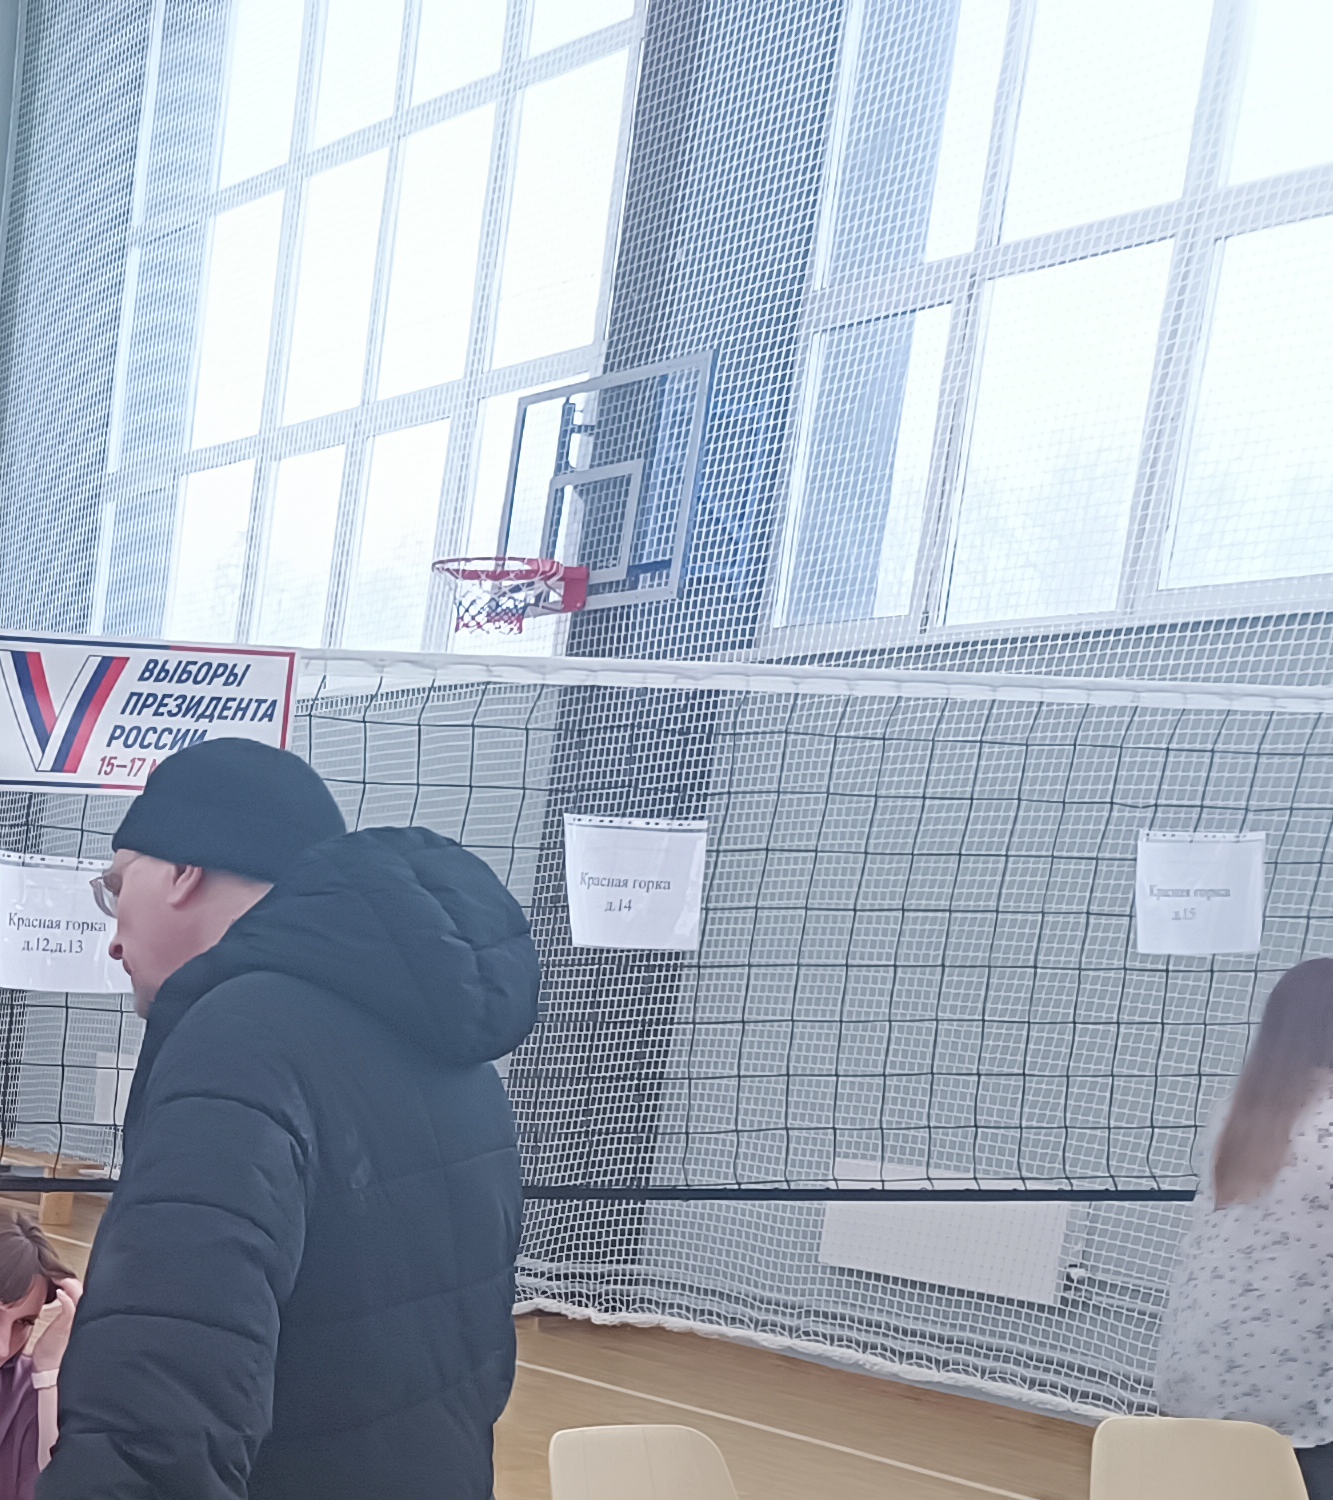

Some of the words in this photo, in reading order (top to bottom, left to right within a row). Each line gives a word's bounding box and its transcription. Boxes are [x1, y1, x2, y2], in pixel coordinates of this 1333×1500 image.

[137, 658, 252, 687] ВЫБОРЫ
[119, 691, 278, 724] ПРЕЗИДЕНТА
[579, 871, 629, 890] Красная
[632, 879, 671, 893] горка
[8, 912, 61, 931] Красная
[65, 920, 106, 935] горка
